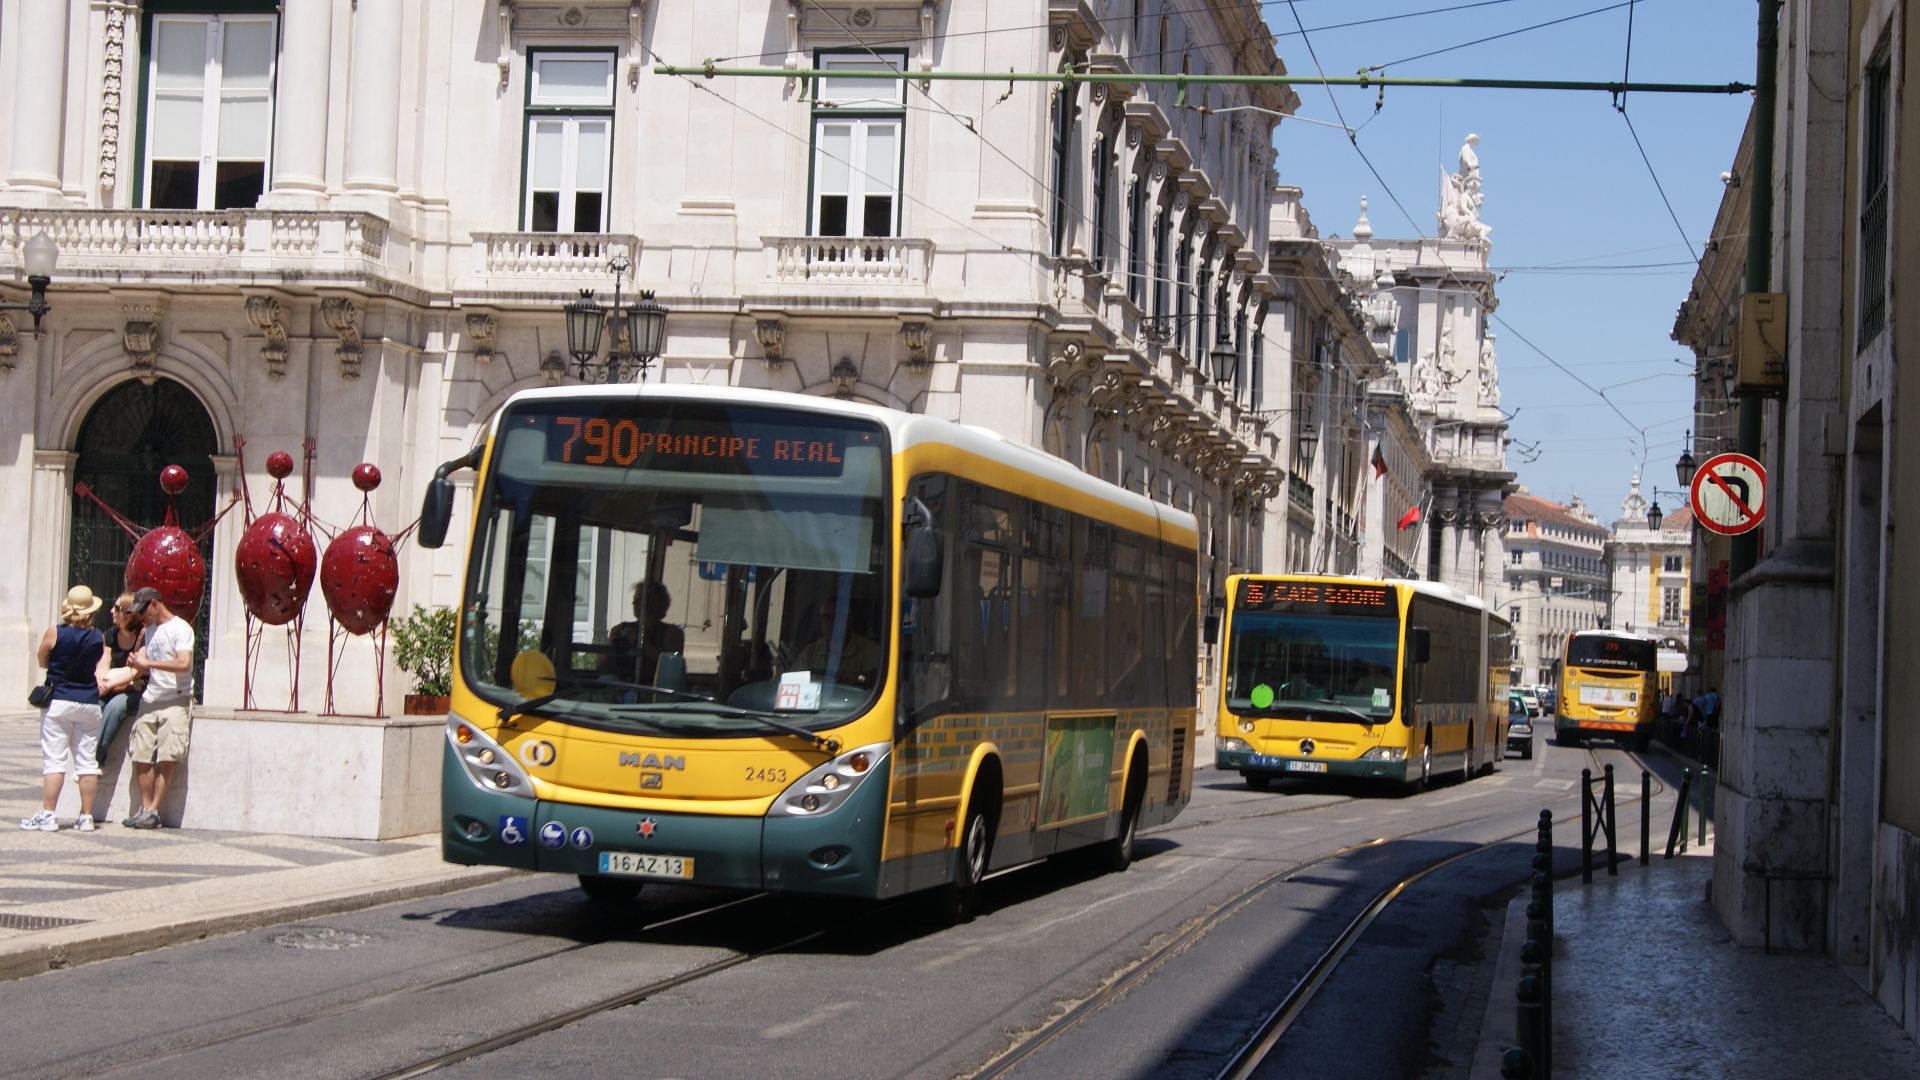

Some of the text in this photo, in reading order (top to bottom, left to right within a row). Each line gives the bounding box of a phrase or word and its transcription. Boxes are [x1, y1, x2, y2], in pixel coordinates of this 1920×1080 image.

[556, 416, 842, 466] 790 PRINCIPE REAL
[1274, 586, 1319, 602] CAIS
[619, 751, 686, 771] MAN
[745, 767, 787, 783] 2453
